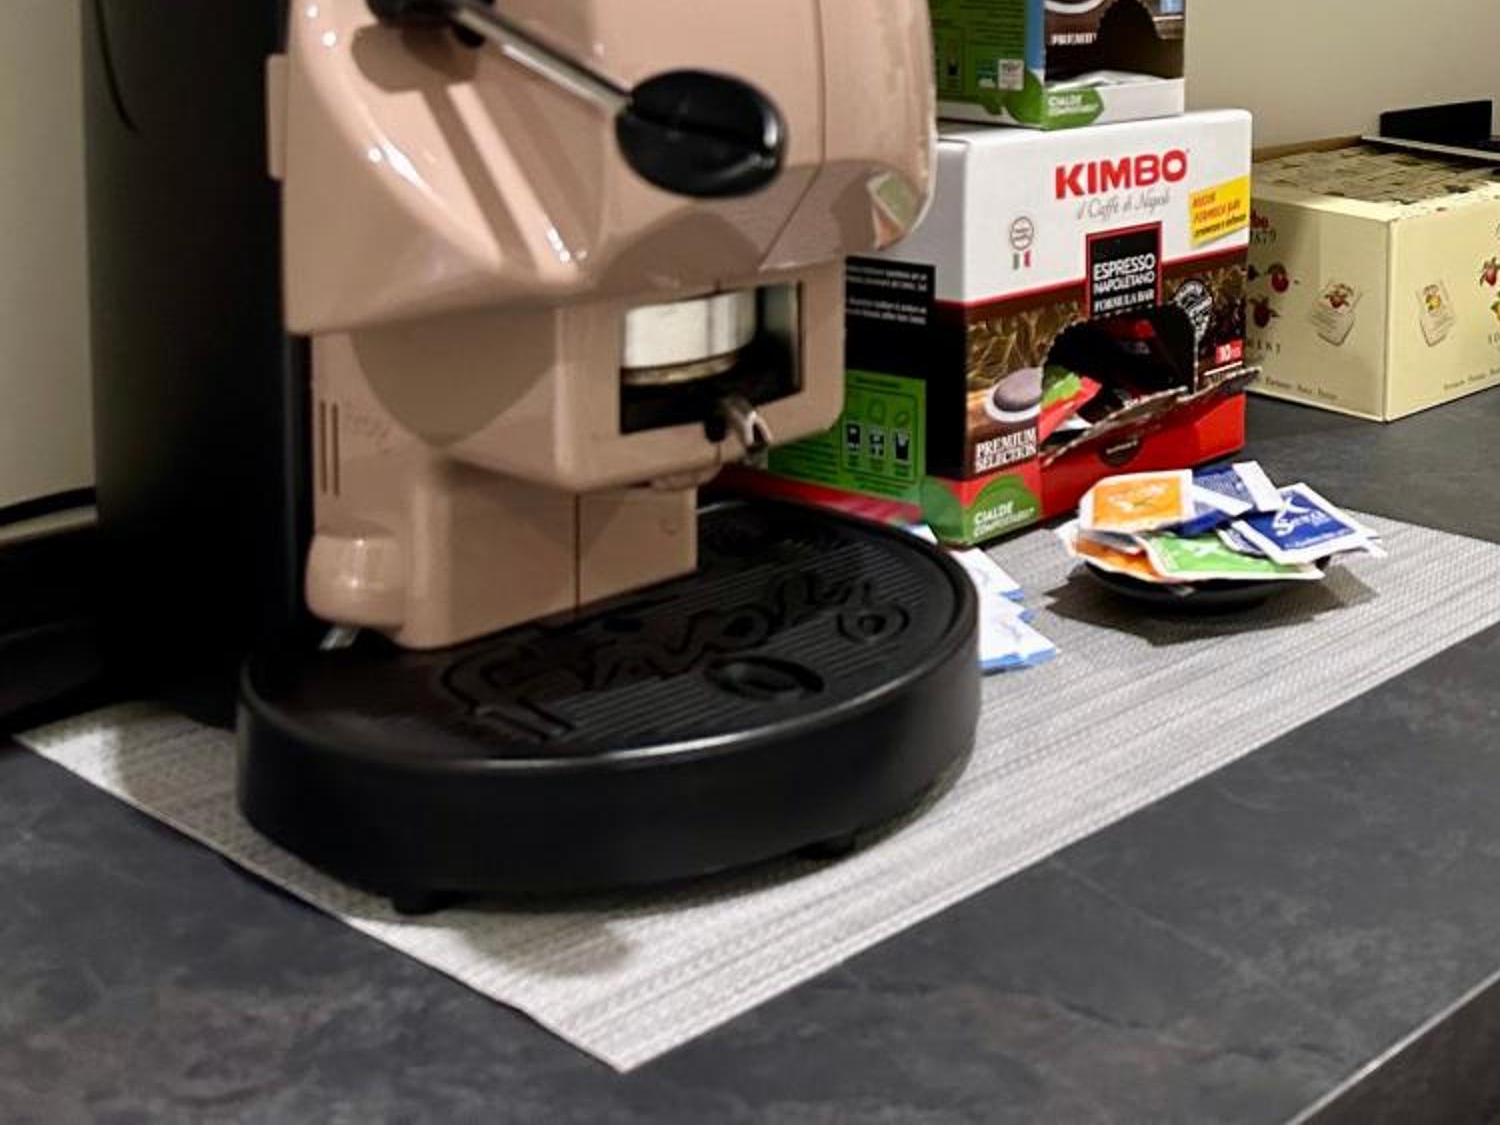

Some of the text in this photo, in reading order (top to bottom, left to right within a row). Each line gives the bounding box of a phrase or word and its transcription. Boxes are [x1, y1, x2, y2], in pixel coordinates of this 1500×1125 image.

[1055, 148, 1188, 200] KIMBO
[1093, 253, 1156, 280] ESPRESSO
[1093, 271, 1155, 295] NAPOLETANO
[974, 442, 1037, 473] SELECTION
[975, 426, 1037, 459] PREMIUM
